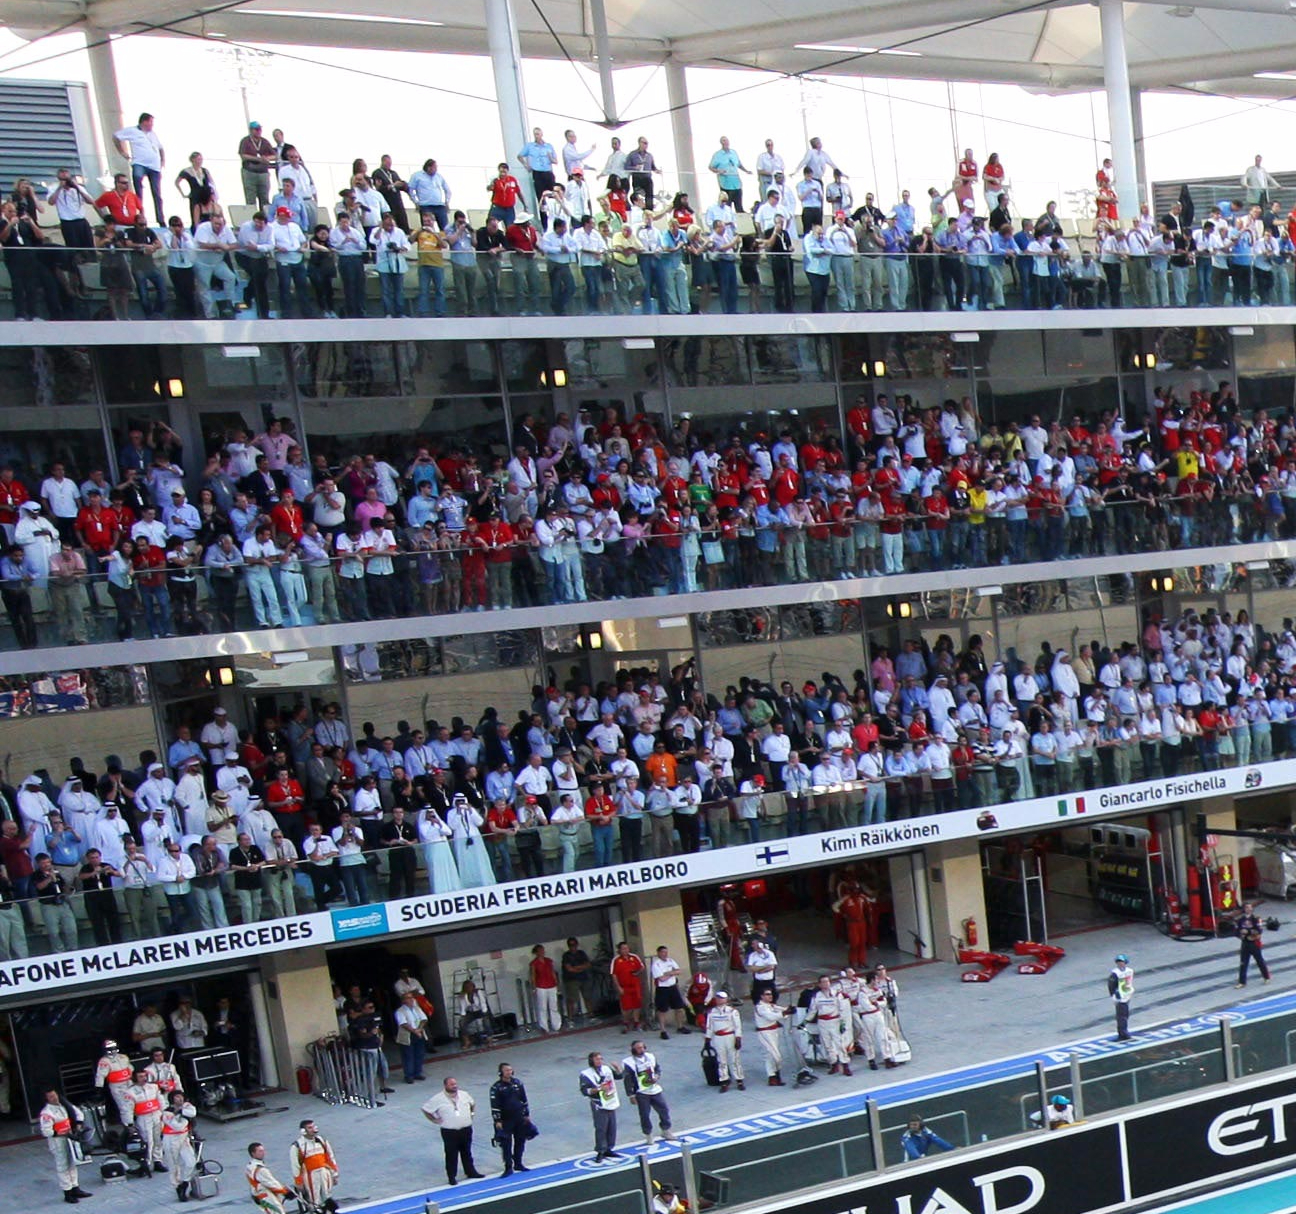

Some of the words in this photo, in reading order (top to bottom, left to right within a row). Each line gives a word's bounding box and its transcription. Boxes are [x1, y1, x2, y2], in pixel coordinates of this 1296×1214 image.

[1099, 787, 1163, 808] Giancarlo
[1165, 776, 1227, 799] Fisichella
[821, 833, 856, 853] Kimi
[861, 823, 940, 846] Räikkönen
[401, 890, 499, 922] SCUDERIA
[504, 879, 584, 910] FERRARI
[589, 861, 689, 892] MARLBORO
[81, 940, 190, 974] McLAREN
[195, 920, 313, 956] MERCEDES
